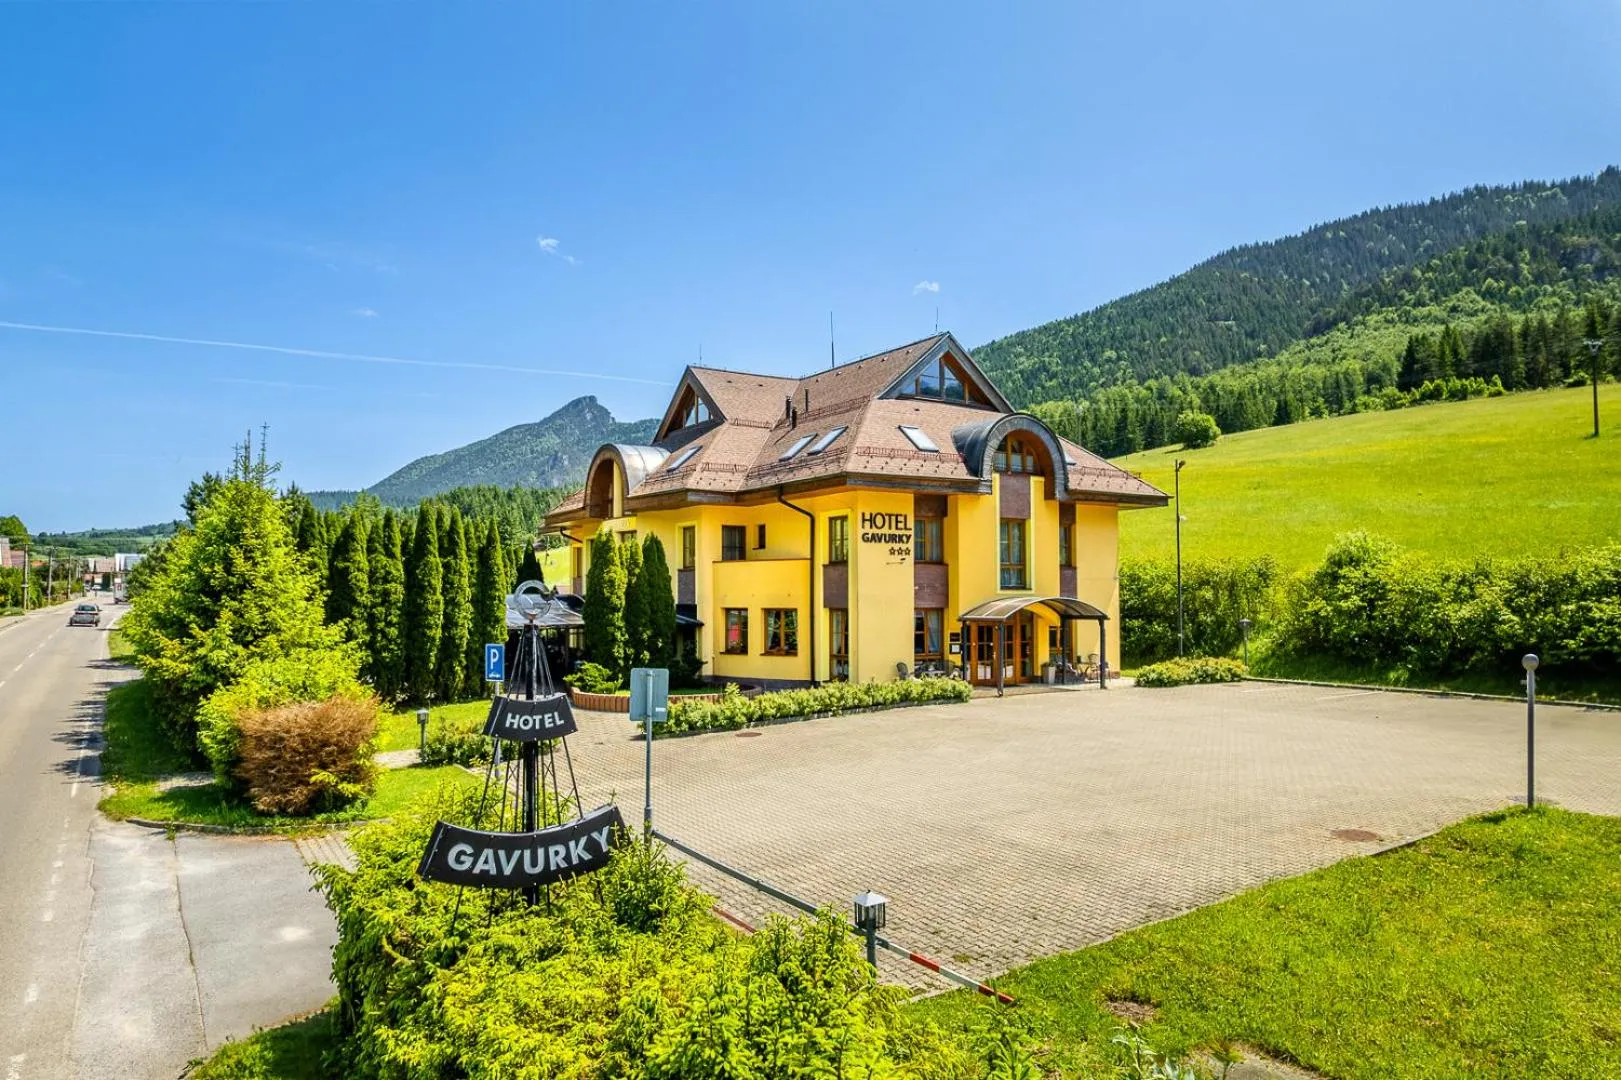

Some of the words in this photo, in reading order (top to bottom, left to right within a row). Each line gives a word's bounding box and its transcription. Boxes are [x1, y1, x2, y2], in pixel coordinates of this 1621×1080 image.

[861, 512, 912, 531] HOTEL
[861, 532, 912, 544] GAVURKY
[490, 648, 499, 670] P
[505, 711, 565, 730] HOTEL
[447, 825, 610, 876] GAVURKY
